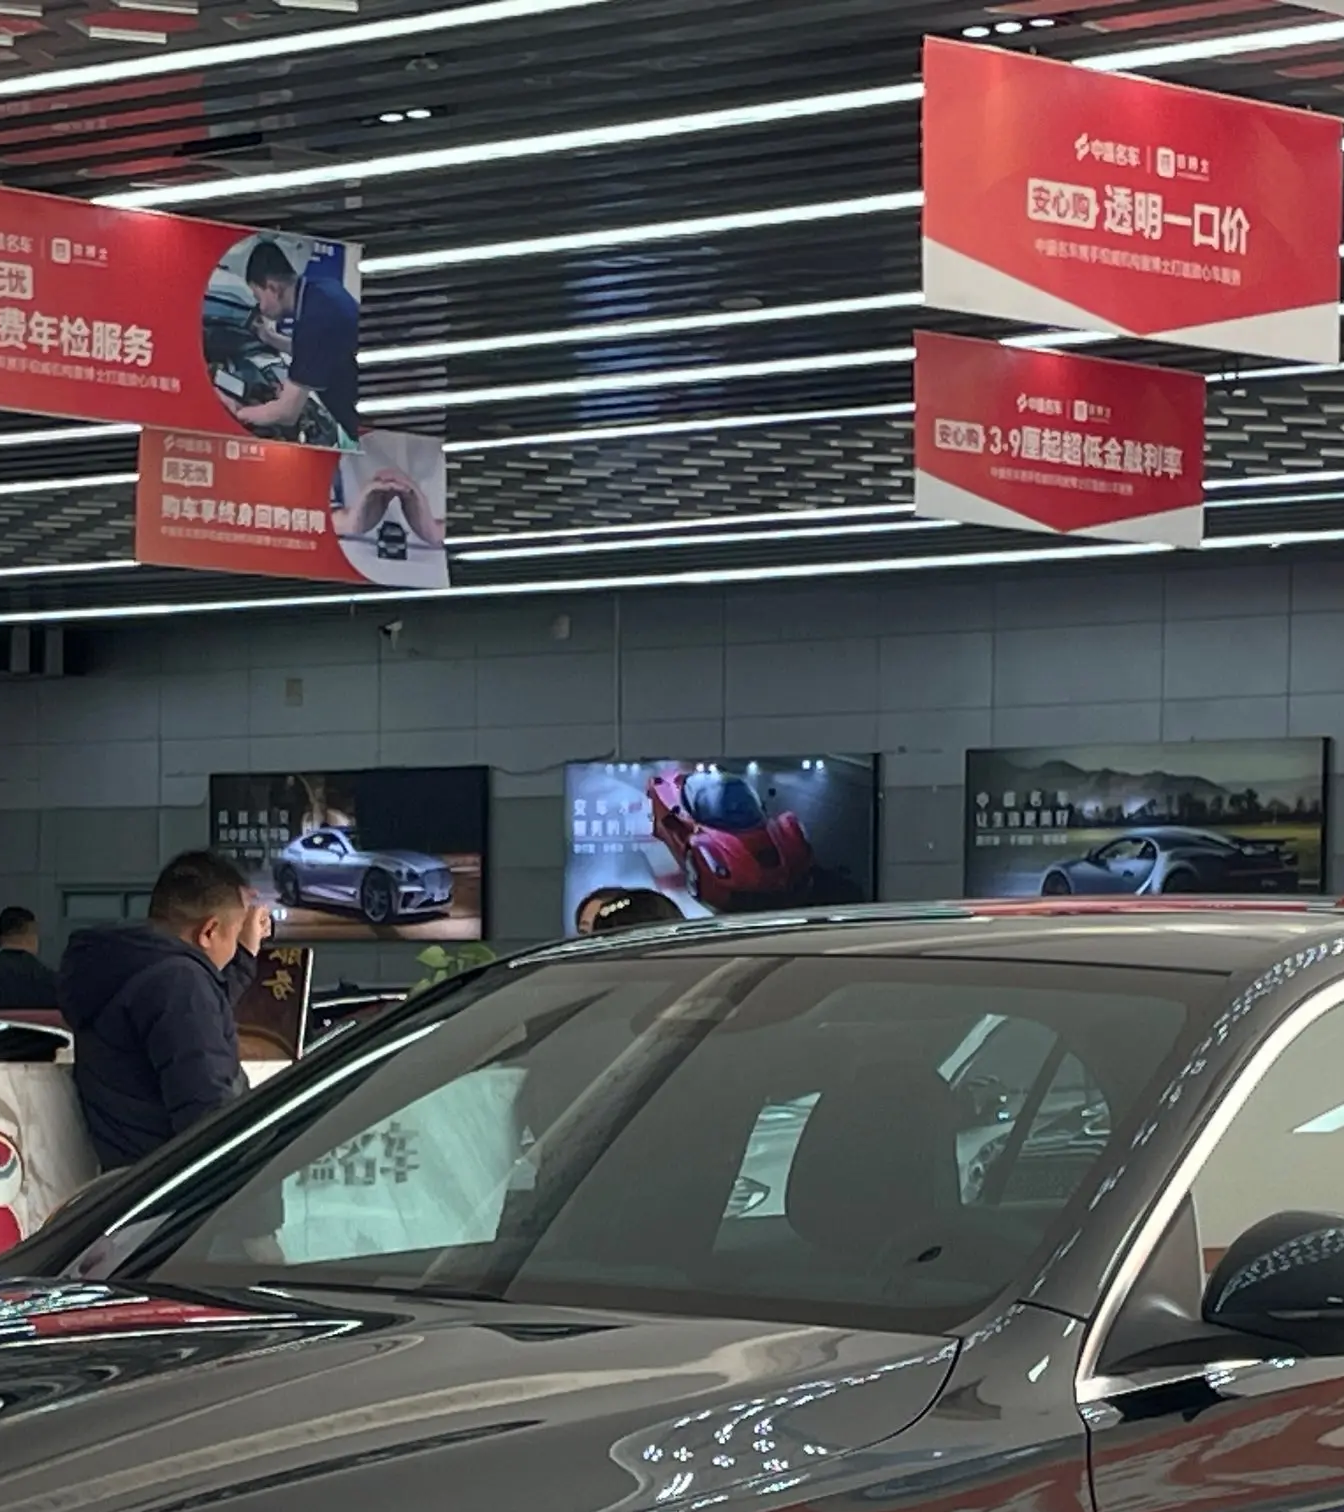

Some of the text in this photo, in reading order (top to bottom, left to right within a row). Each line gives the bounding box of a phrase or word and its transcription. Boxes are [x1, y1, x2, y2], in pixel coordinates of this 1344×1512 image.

[1090, 138, 1141, 167] 中盛名车
[1032, 182, 1251, 256] 安心购 透明一口价
[165, 461, 210, 483] 用无忧
[937, 423, 1185, 481] 安心购 3.9厘起超低金融利率
